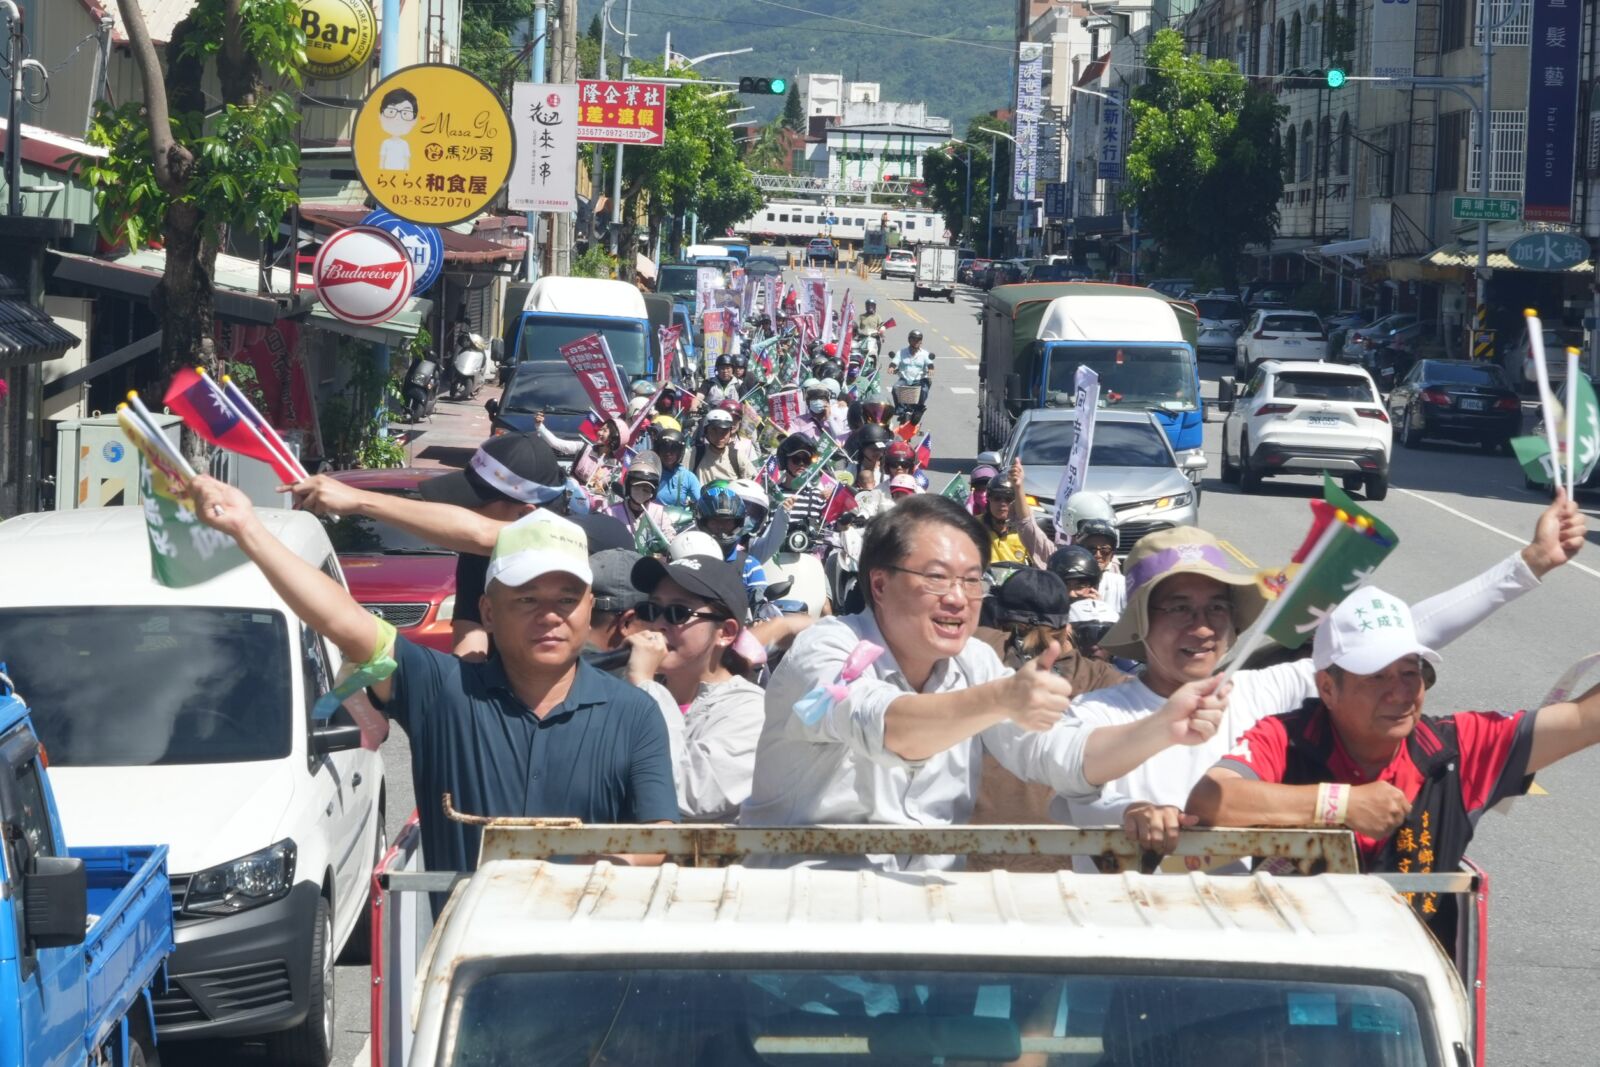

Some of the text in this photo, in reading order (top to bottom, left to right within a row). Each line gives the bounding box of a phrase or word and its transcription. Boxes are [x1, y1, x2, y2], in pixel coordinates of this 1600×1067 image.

[301, 9, 357, 45] Bar
[577, 83, 661, 106] 隆企業社
[420, 112, 472, 138] Masa
[445, 145, 493, 162] 馬沙哥
[1545, 107, 1558, 177] hair salon
[392, 194, 471, 208] 03-8527070
[1516, 235, 1583, 268] 加水站
[325, 264, 400, 280] Budweiser
